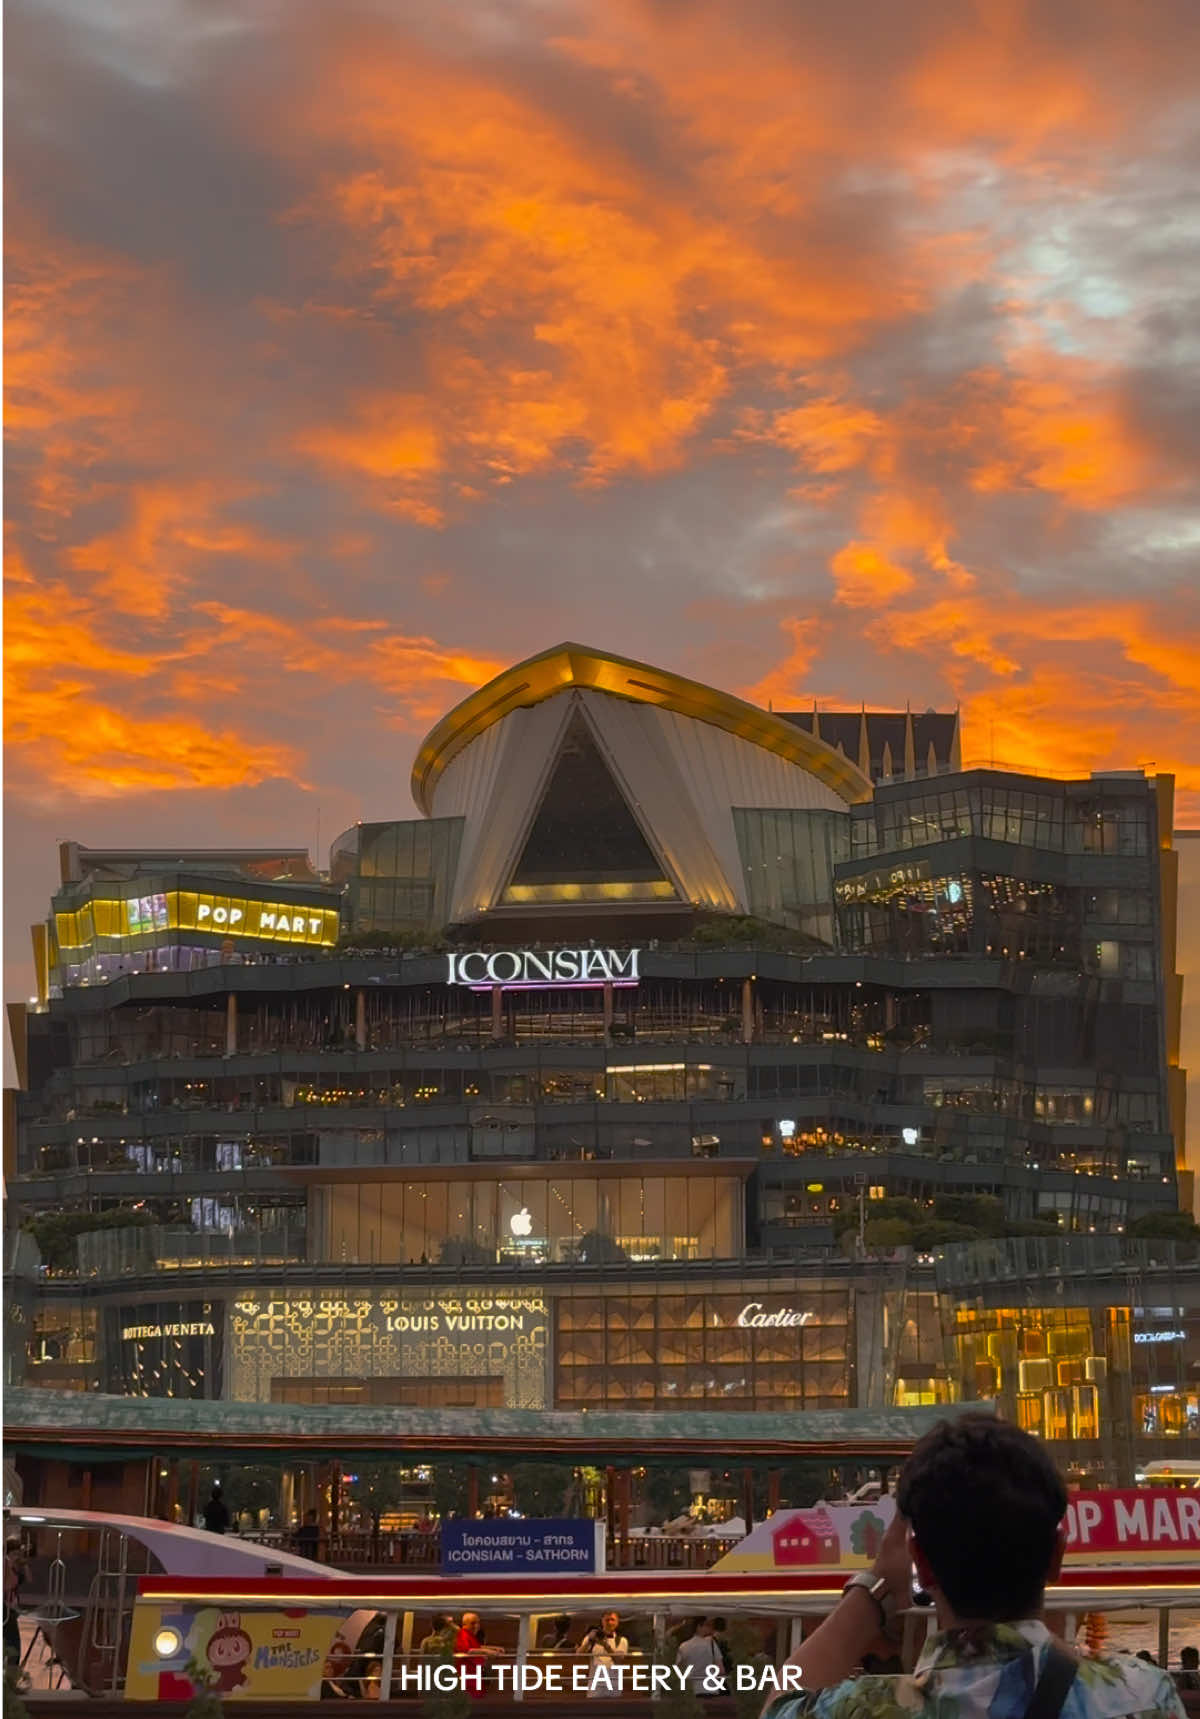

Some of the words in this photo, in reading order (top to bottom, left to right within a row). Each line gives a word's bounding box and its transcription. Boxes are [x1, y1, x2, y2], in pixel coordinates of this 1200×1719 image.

[198, 904, 242, 925] POP
[260, 912, 321, 934] MART
[446, 949, 640, 985] ICONSIAM
[386, 1315, 439, 1331] LOUIS
[445, 1315, 523, 1331] VUITTON
[737, 1303, 813, 1328] Cartier
[164, 1323, 215, 1336] VENETA
[448, 1550, 513, 1561] ICONSIAM
[525, 1549, 589, 1561] SATHORN
[271, 1642, 292, 1655] THE
